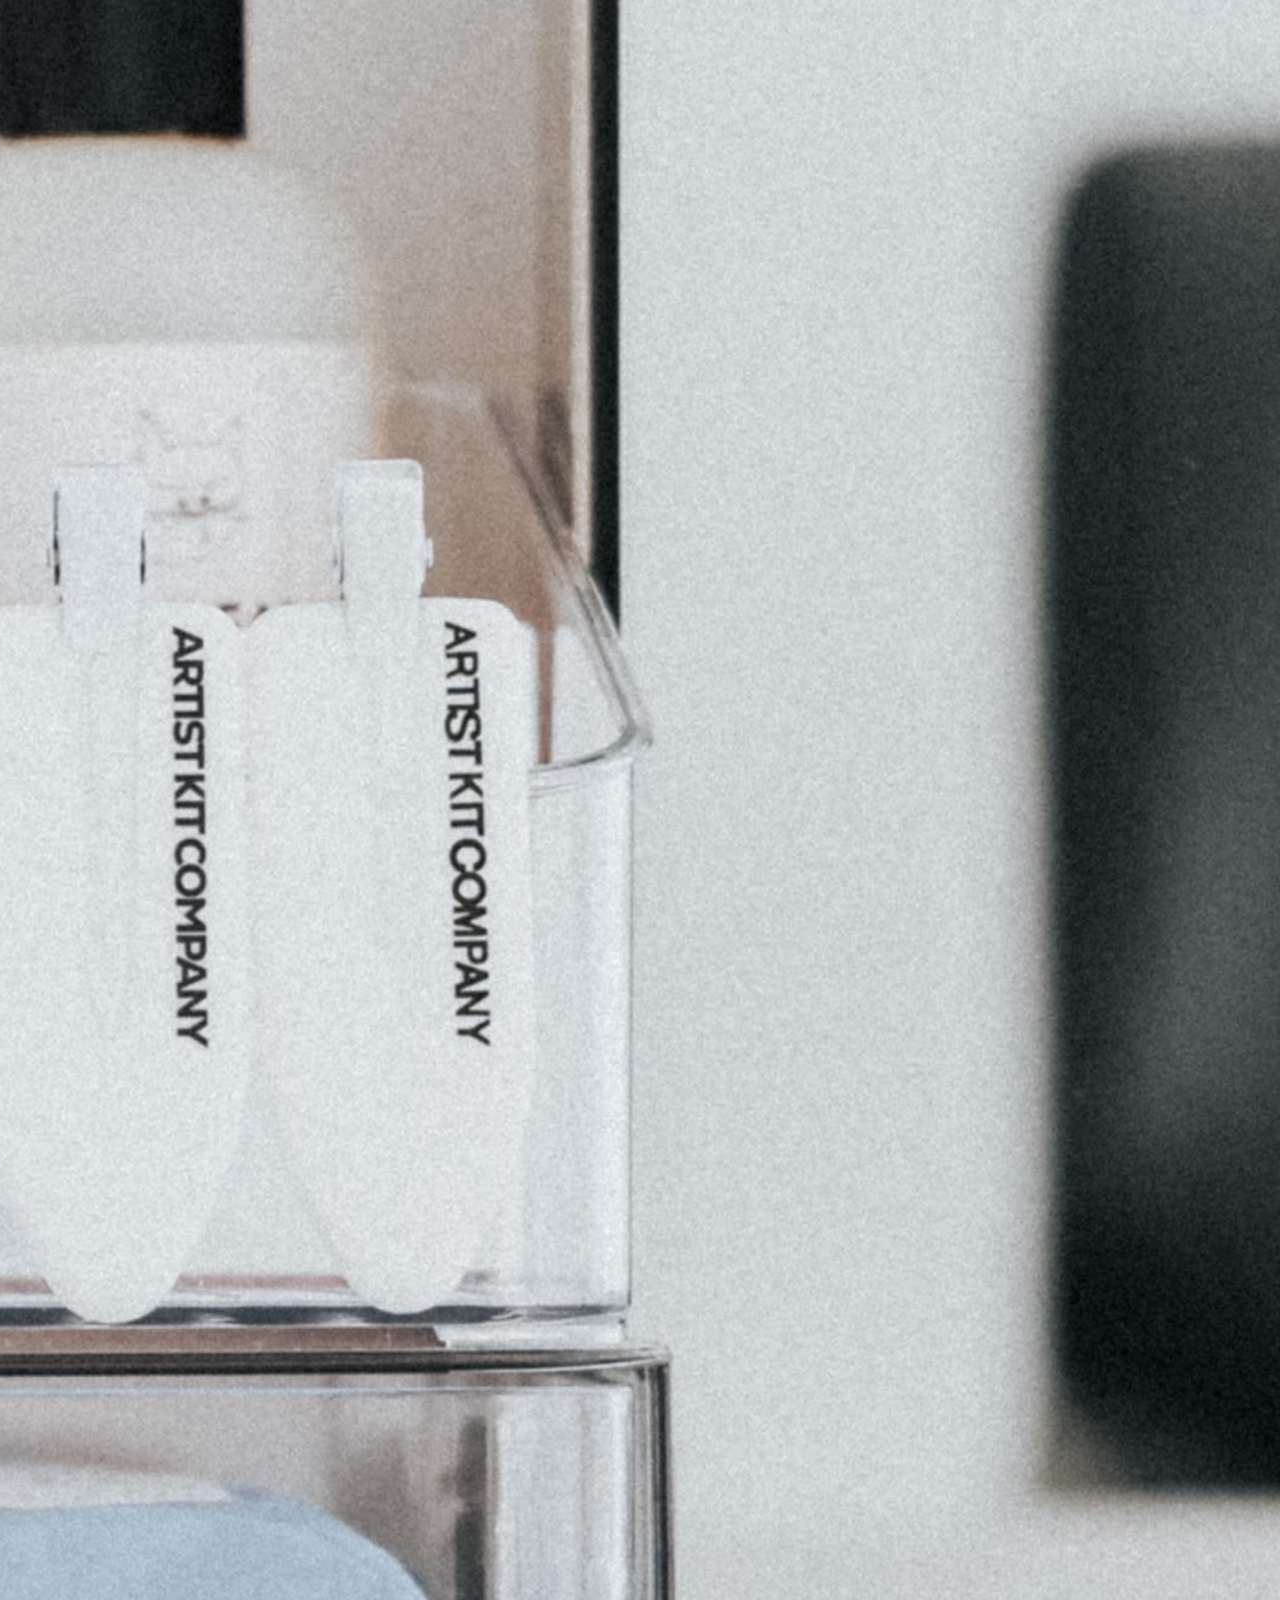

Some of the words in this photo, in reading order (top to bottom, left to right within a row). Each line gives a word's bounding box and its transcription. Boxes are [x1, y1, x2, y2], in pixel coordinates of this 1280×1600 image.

[172, 627, 205, 769] ARTIST
[444, 622, 483, 765] ARTIST
[174, 774, 206, 835] KIT
[448, 771, 486, 837] KIT
[174, 838, 209, 1048] COMPANY
[449, 838, 491, 1047] COMPANY
